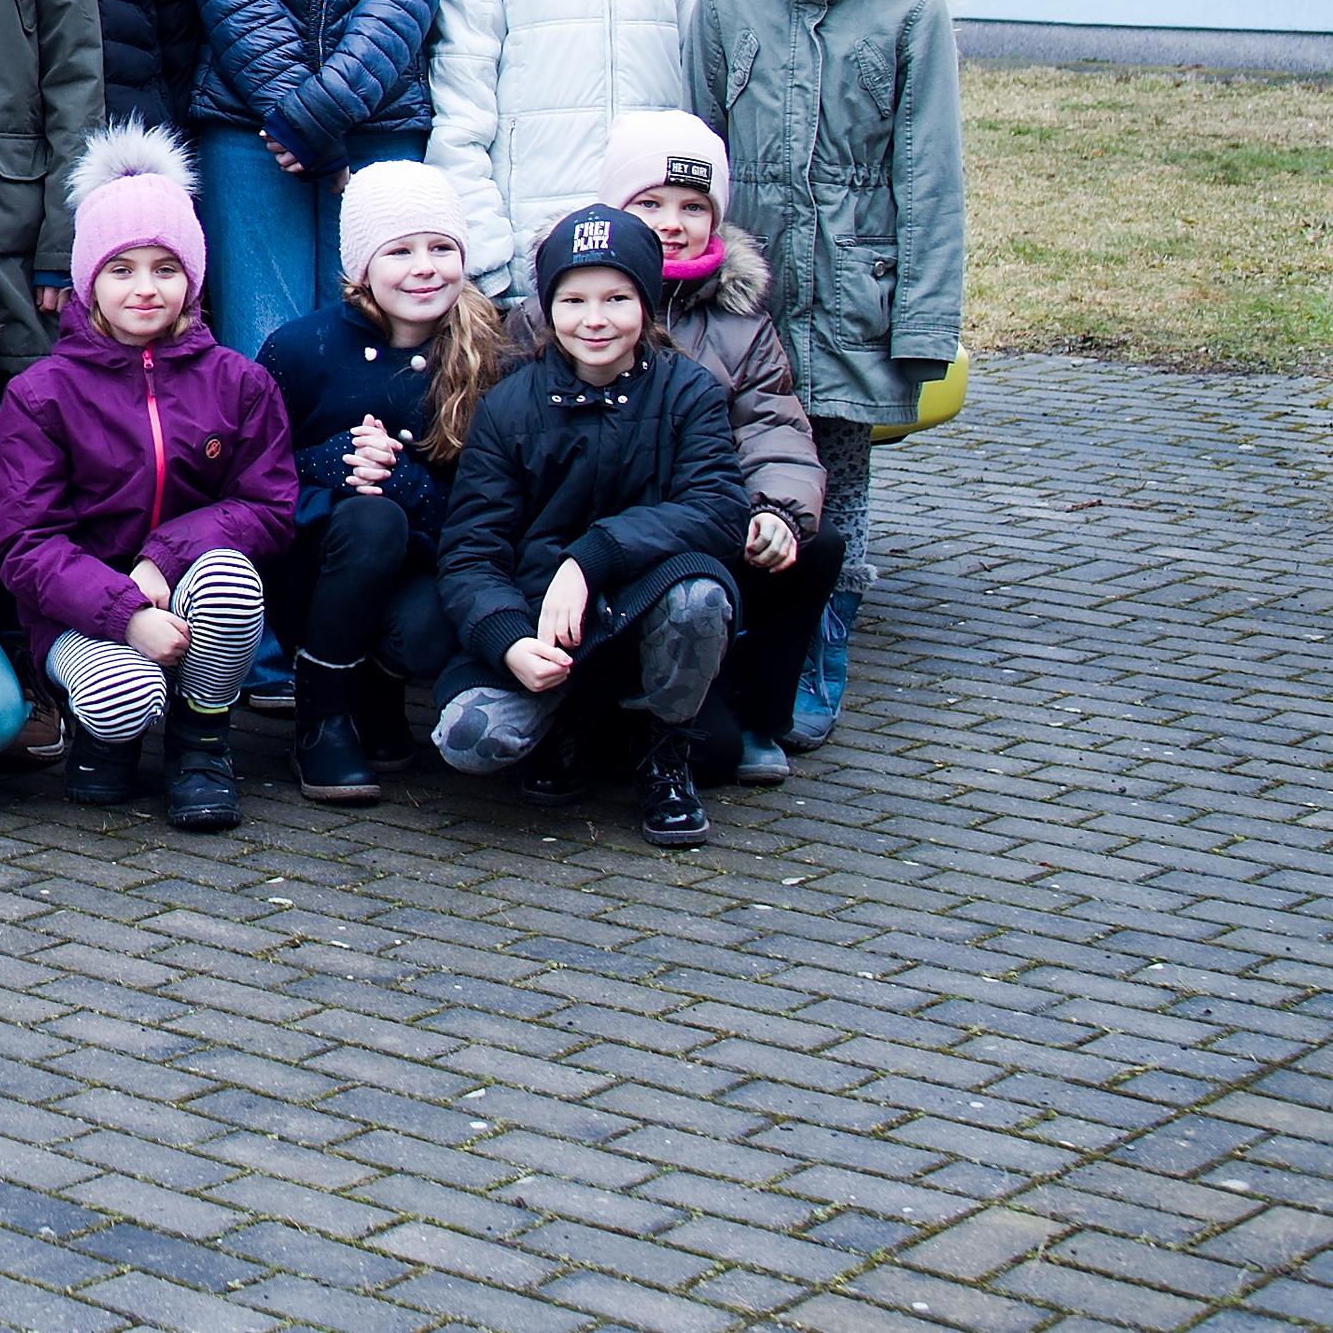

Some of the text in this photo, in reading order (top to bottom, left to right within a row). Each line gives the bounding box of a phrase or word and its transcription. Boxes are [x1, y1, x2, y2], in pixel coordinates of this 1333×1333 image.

[671, 162, 689, 174] HEY
[574, 220, 611, 240] FREI
[573, 235, 610, 253] PLATZ
